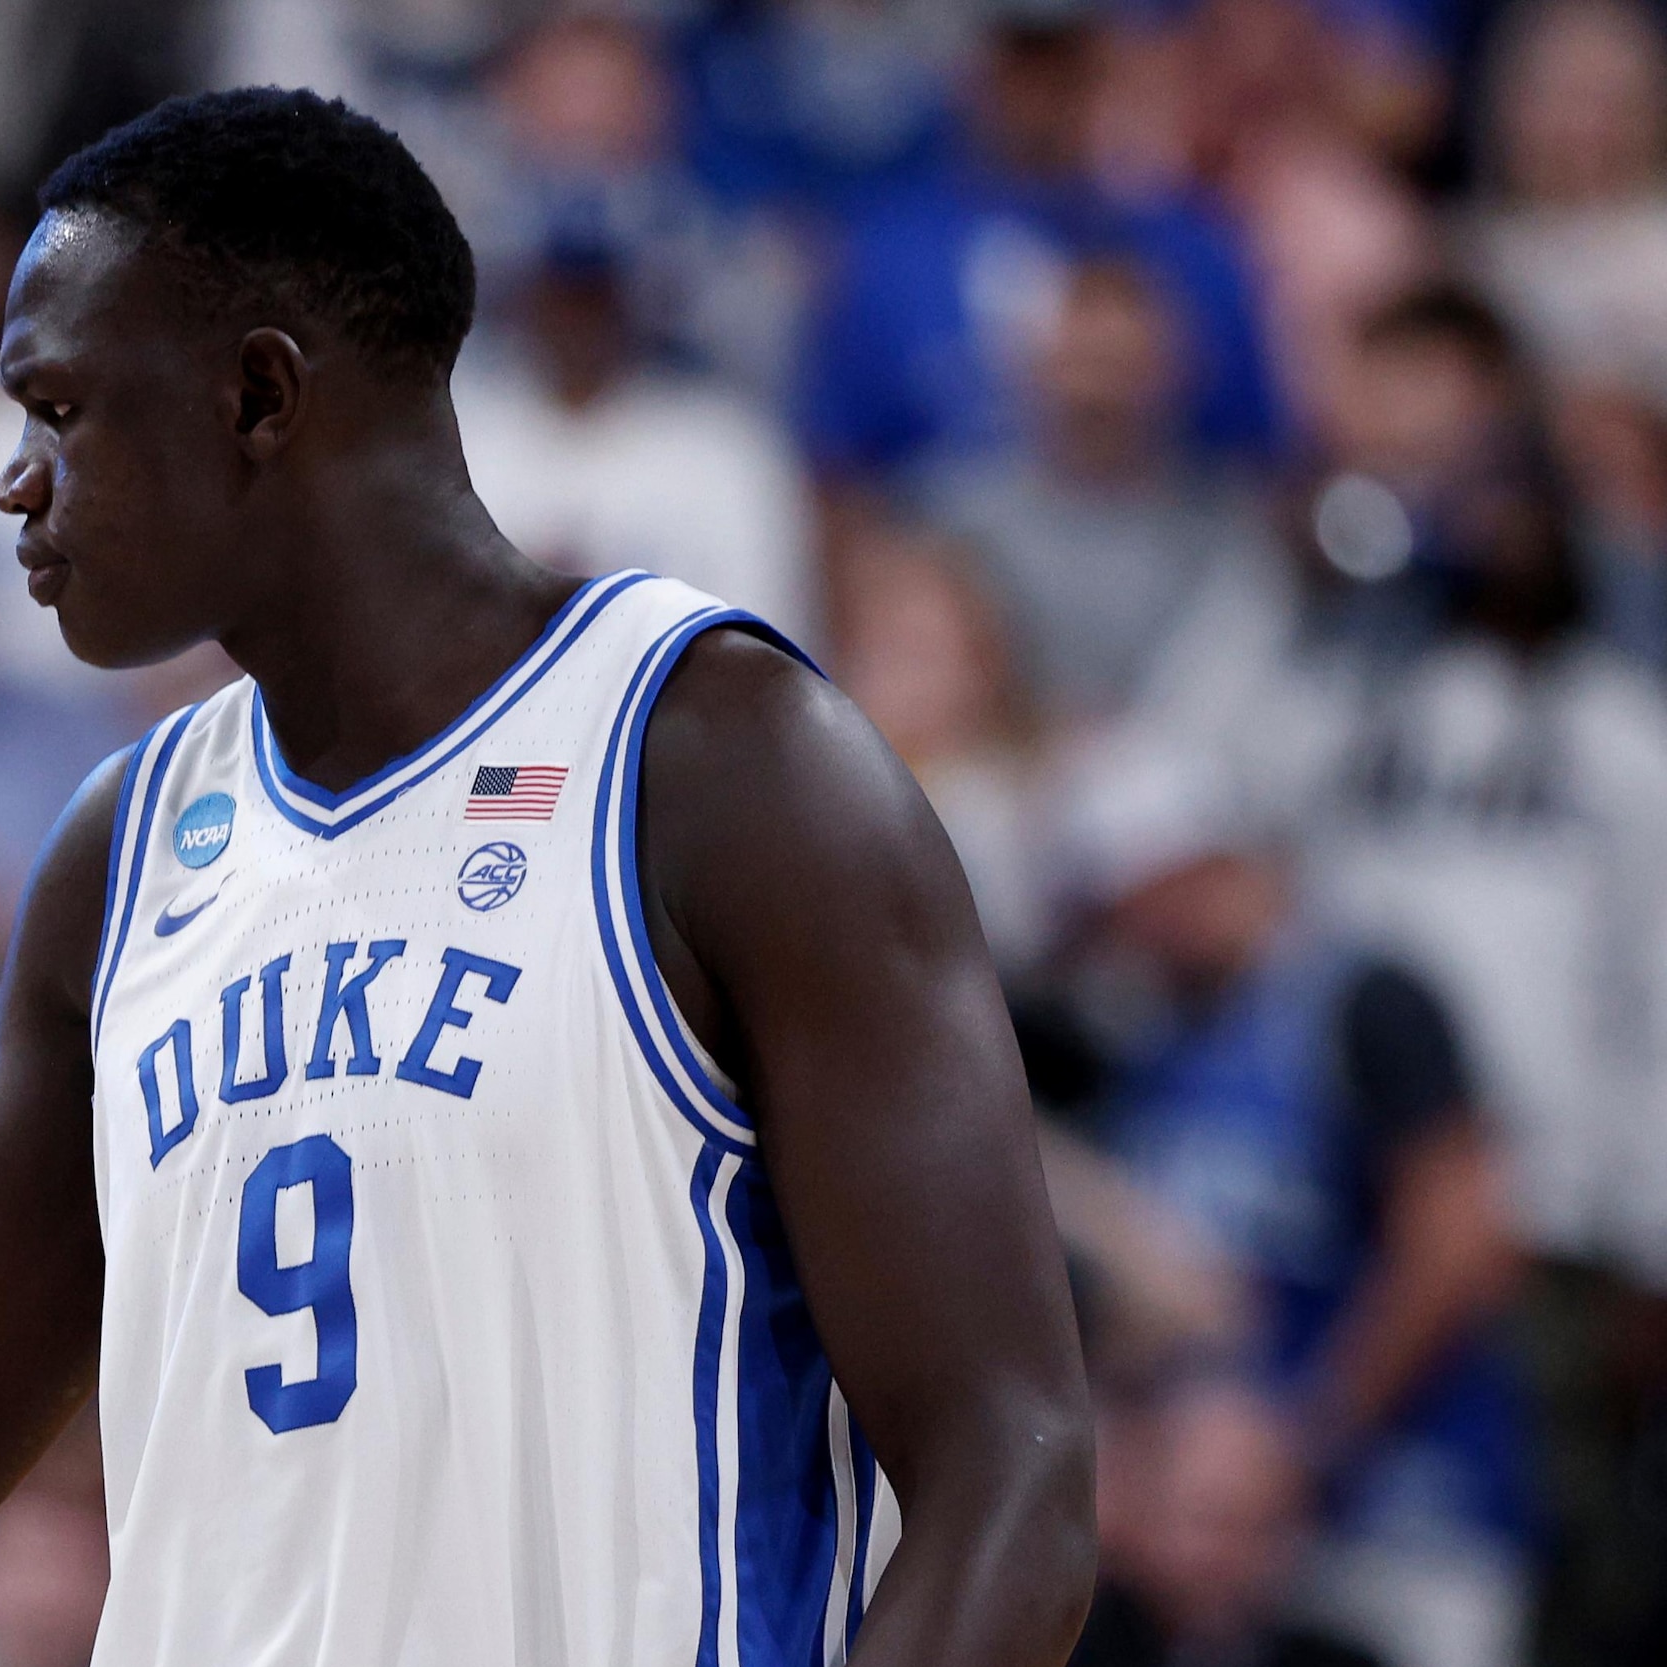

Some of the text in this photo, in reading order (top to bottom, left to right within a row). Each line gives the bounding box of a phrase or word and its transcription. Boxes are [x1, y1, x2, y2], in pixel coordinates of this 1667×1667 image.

[180, 822, 229, 851] NCAA
[467, 864, 524, 884] ACC
[137, 938, 522, 1170] DUKE
[237, 1133, 358, 1435] 9
